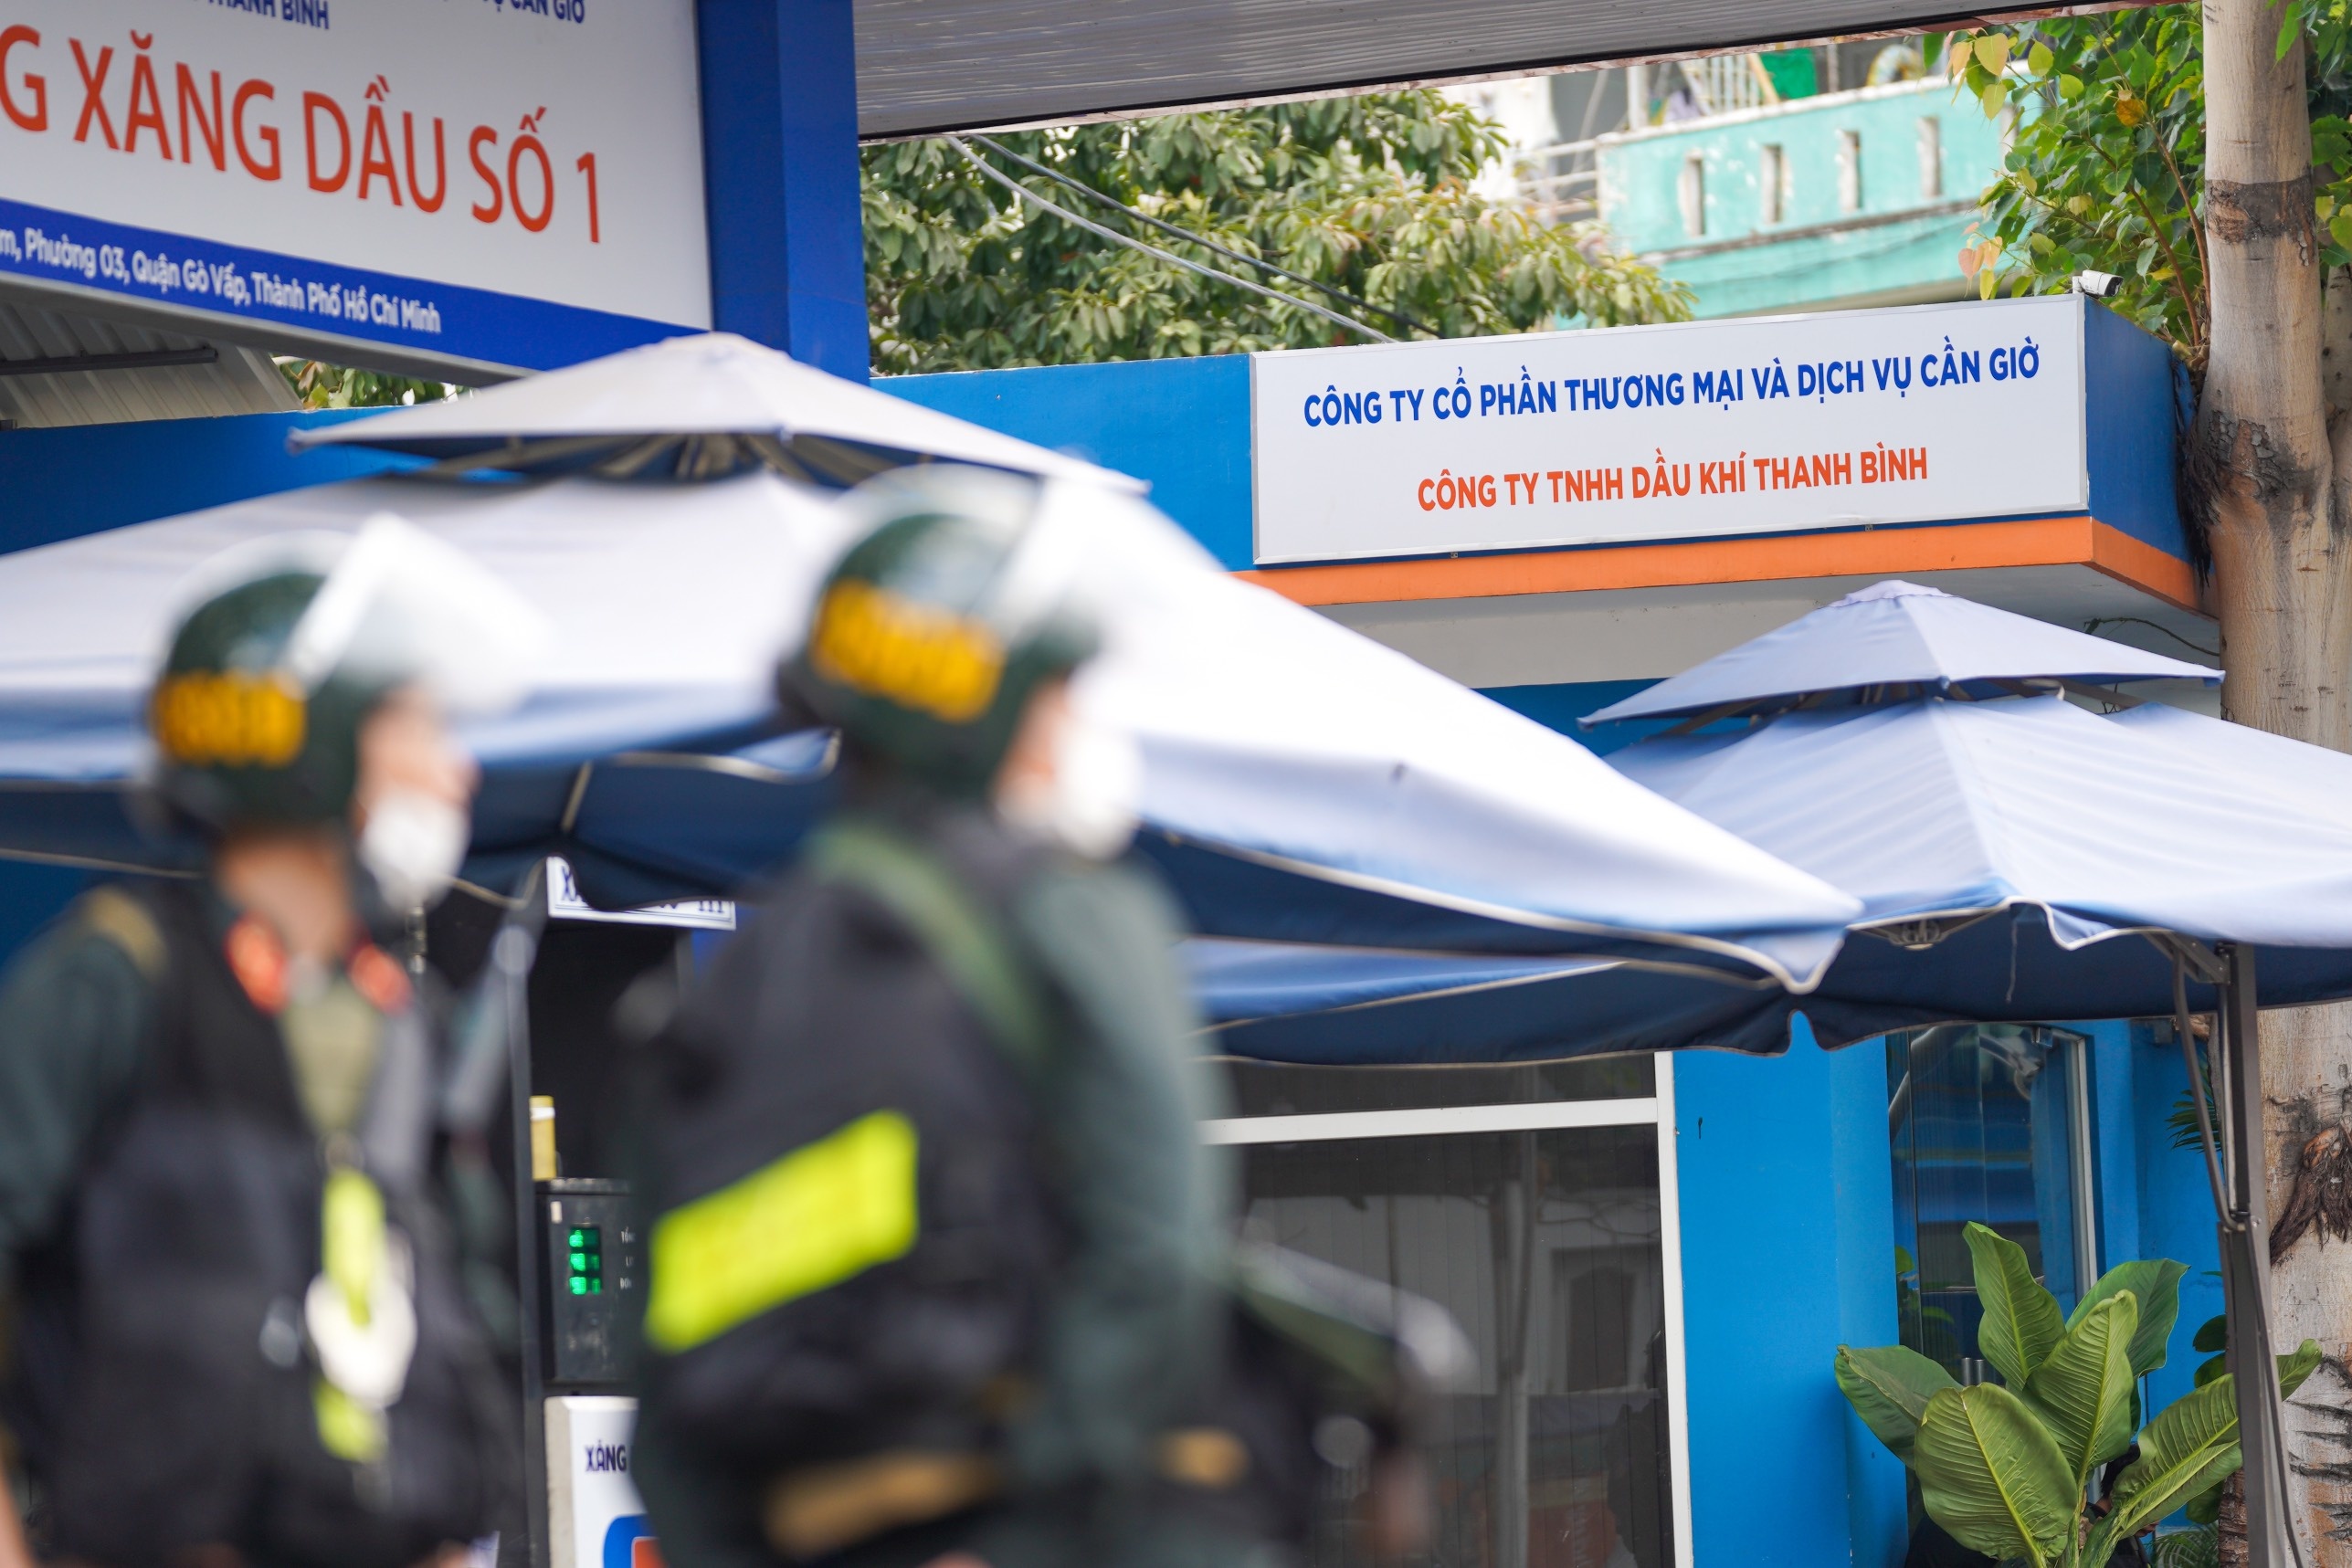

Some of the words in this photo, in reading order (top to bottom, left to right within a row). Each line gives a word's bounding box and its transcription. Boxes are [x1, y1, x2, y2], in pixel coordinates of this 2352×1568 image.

[70, 34, 280, 182] XĂNG
[303, 75, 446, 214] DẦU
[469, 107, 554, 233] SỐ
[577, 153, 599, 243] 1
[25, 227, 97, 279] Phường
[100, 244, 131, 285] 03,
[132, 249, 181, 294] Quận
[183, 258, 210, 293] Gò
[209, 262, 251, 307] Vấp,
[251, 272, 305, 311] Thành
[307, 281, 342, 317] Phố
[343, 284, 369, 322] Hồ
[371, 293, 399, 327] Chí
[401, 299, 442, 333] Minh
[1303, 384, 1382, 427] CÔNG
[1389, 389, 1424, 422] TY
[1432, 366, 1471, 420] CỔ
[1480, 365, 1556, 416] PHẦN
[1565, 373, 1684, 411] THƯƠNG
[1693, 369, 1744, 411] MẠI
[1751, 357, 1790, 399] VÀ
[1798, 361, 1864, 404] DỊCH
[1872, 357, 1912, 397] VỤ
[1920, 335, 1980, 387] CẦN
[1988, 336, 2040, 381] GIỜ
[1418, 468, 1497, 511] CÔNG
[1503, 472, 1539, 505] TY
[1546, 468, 1623, 503] TNHH
[1631, 447, 1691, 498] DẦU
[1699, 451, 1746, 494] KHÍ
[1753, 452, 1851, 490] THANH
[1860, 441, 1928, 483] BÌNH
